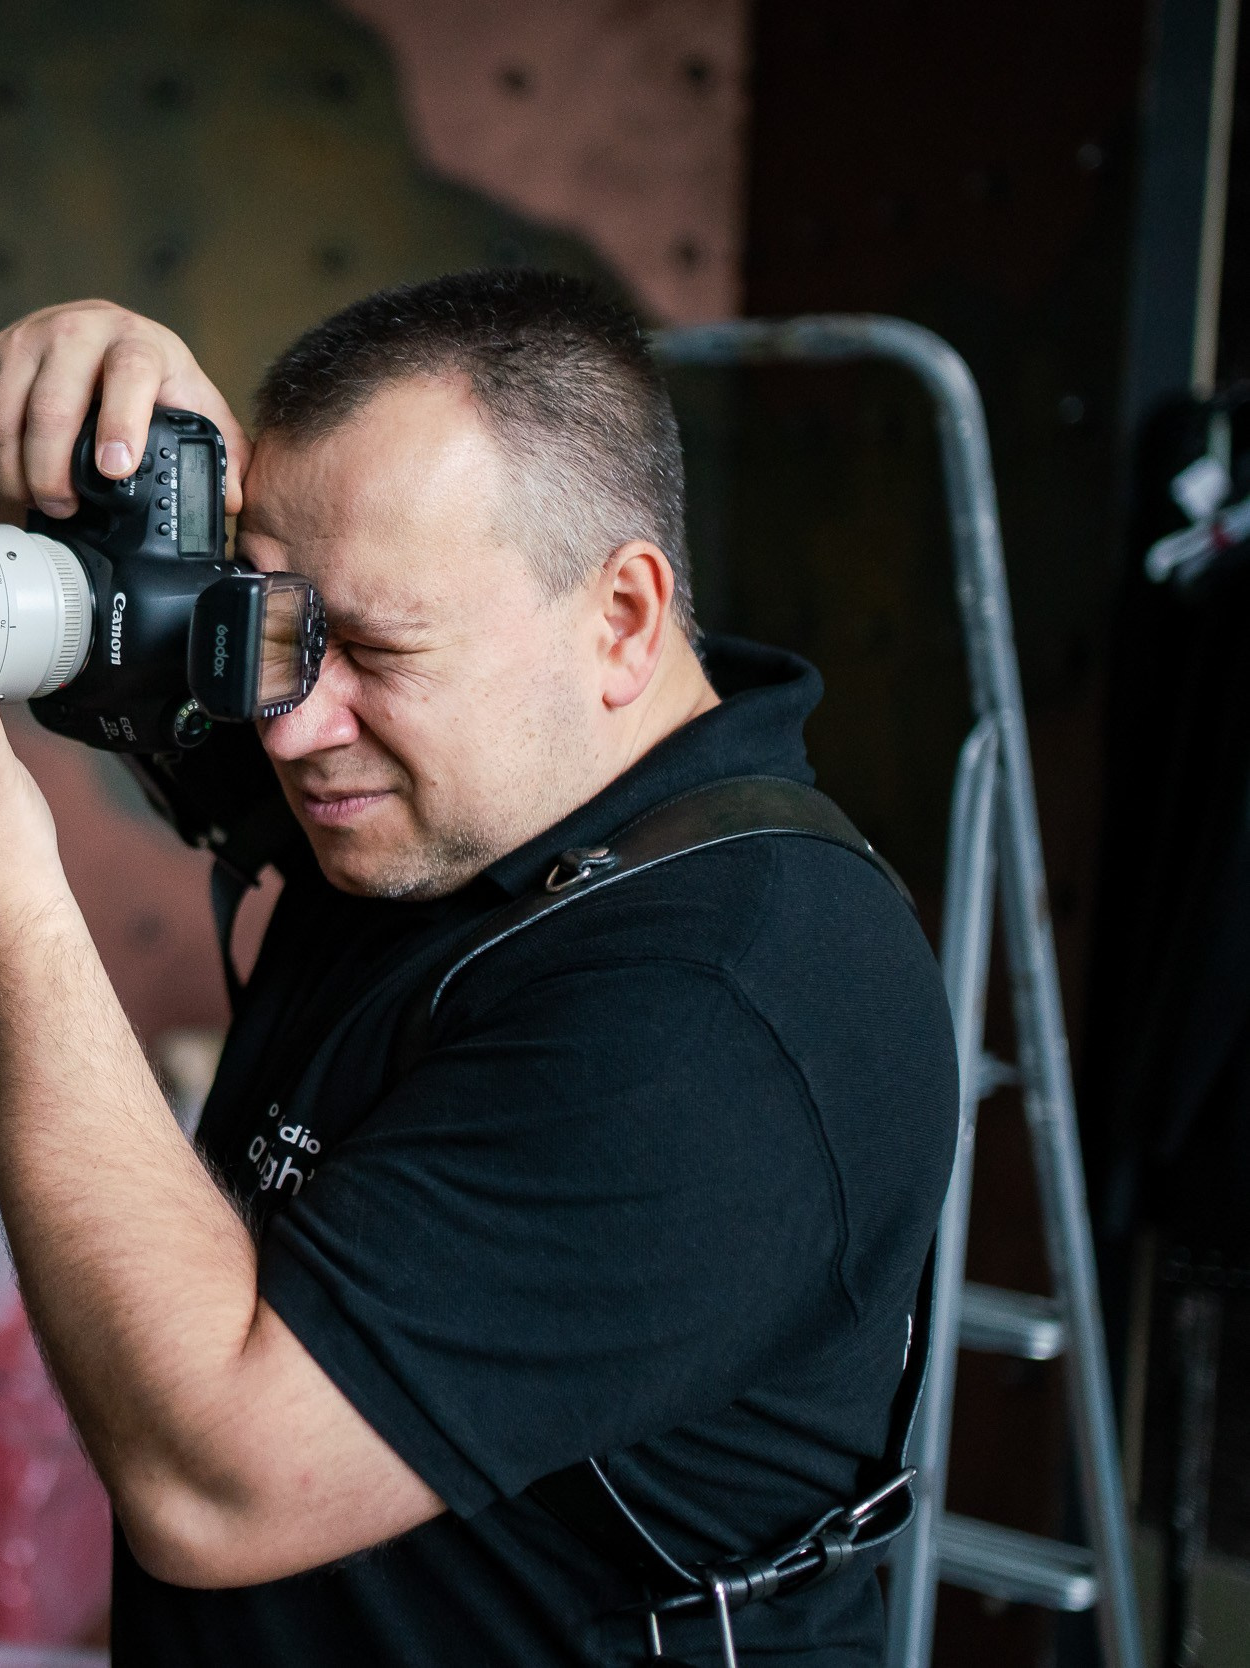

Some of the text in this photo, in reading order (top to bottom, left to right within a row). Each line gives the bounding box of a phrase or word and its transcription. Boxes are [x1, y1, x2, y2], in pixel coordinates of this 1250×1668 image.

[0, 619, 7, 629] 70
[110, 592, 127, 666] Canon
[214, 624, 229, 678] Godox
[119, 717, 137, 742] EOS
